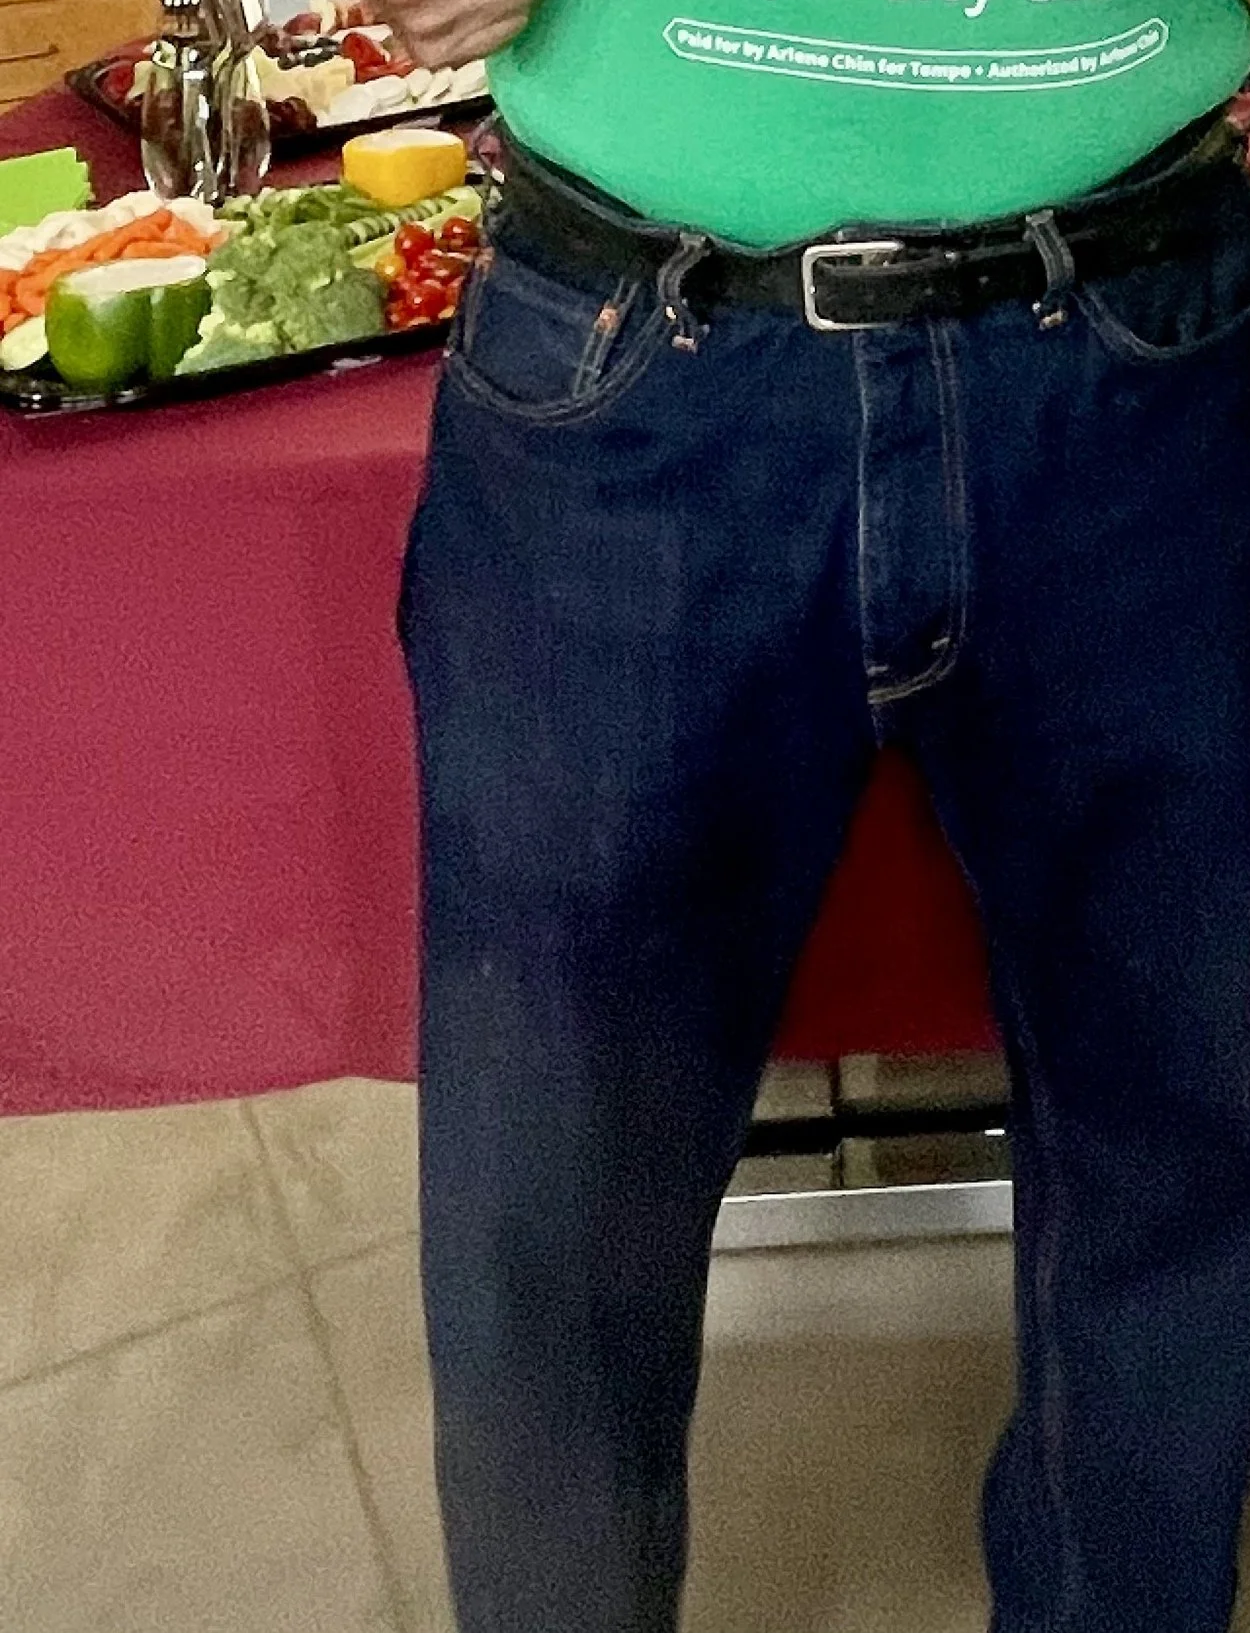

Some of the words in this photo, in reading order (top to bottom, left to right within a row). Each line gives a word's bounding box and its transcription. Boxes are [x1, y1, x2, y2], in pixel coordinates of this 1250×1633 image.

[743, 40, 765, 61] by
[767, 44, 829, 68] Arlene
[832, 54, 876, 74] Chin
